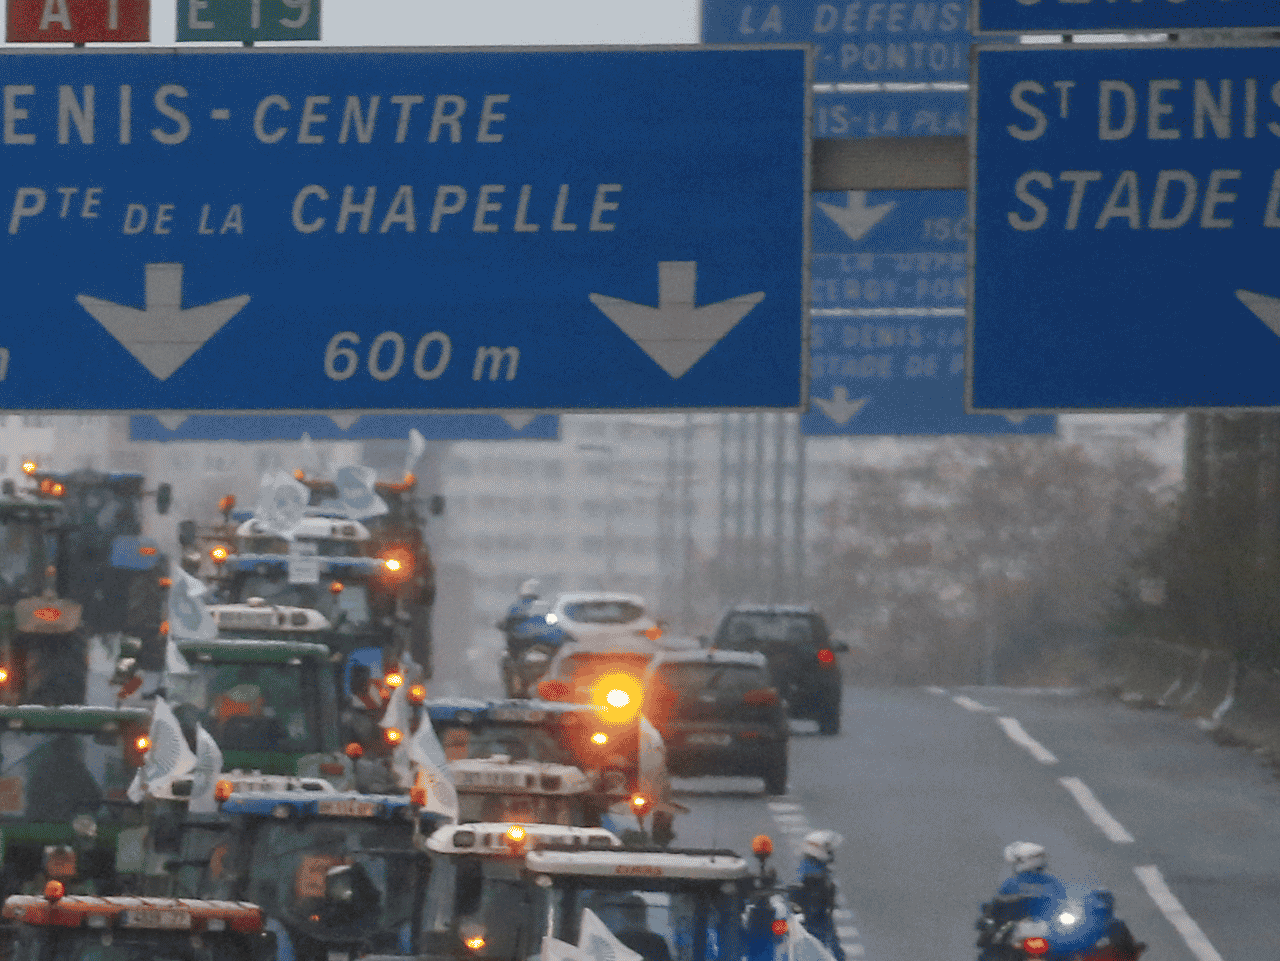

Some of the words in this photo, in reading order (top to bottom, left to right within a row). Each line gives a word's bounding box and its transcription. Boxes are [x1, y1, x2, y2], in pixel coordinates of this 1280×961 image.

[39, 0, 71, 30] A
[188, 0, 215, 29] E
[251, 0, 311, 29] 19
[739, 4, 784, 34] LA
[1007, 80, 1075, 142] ST
[122, 203, 175, 235] DE
[197, 203, 244, 235] LA
[291, 183, 623, 234] CHAPELLE
[1007, 169, 1241, 231] STADE
[324, 330, 452, 381] 600
[472, 346, 520, 381] m
